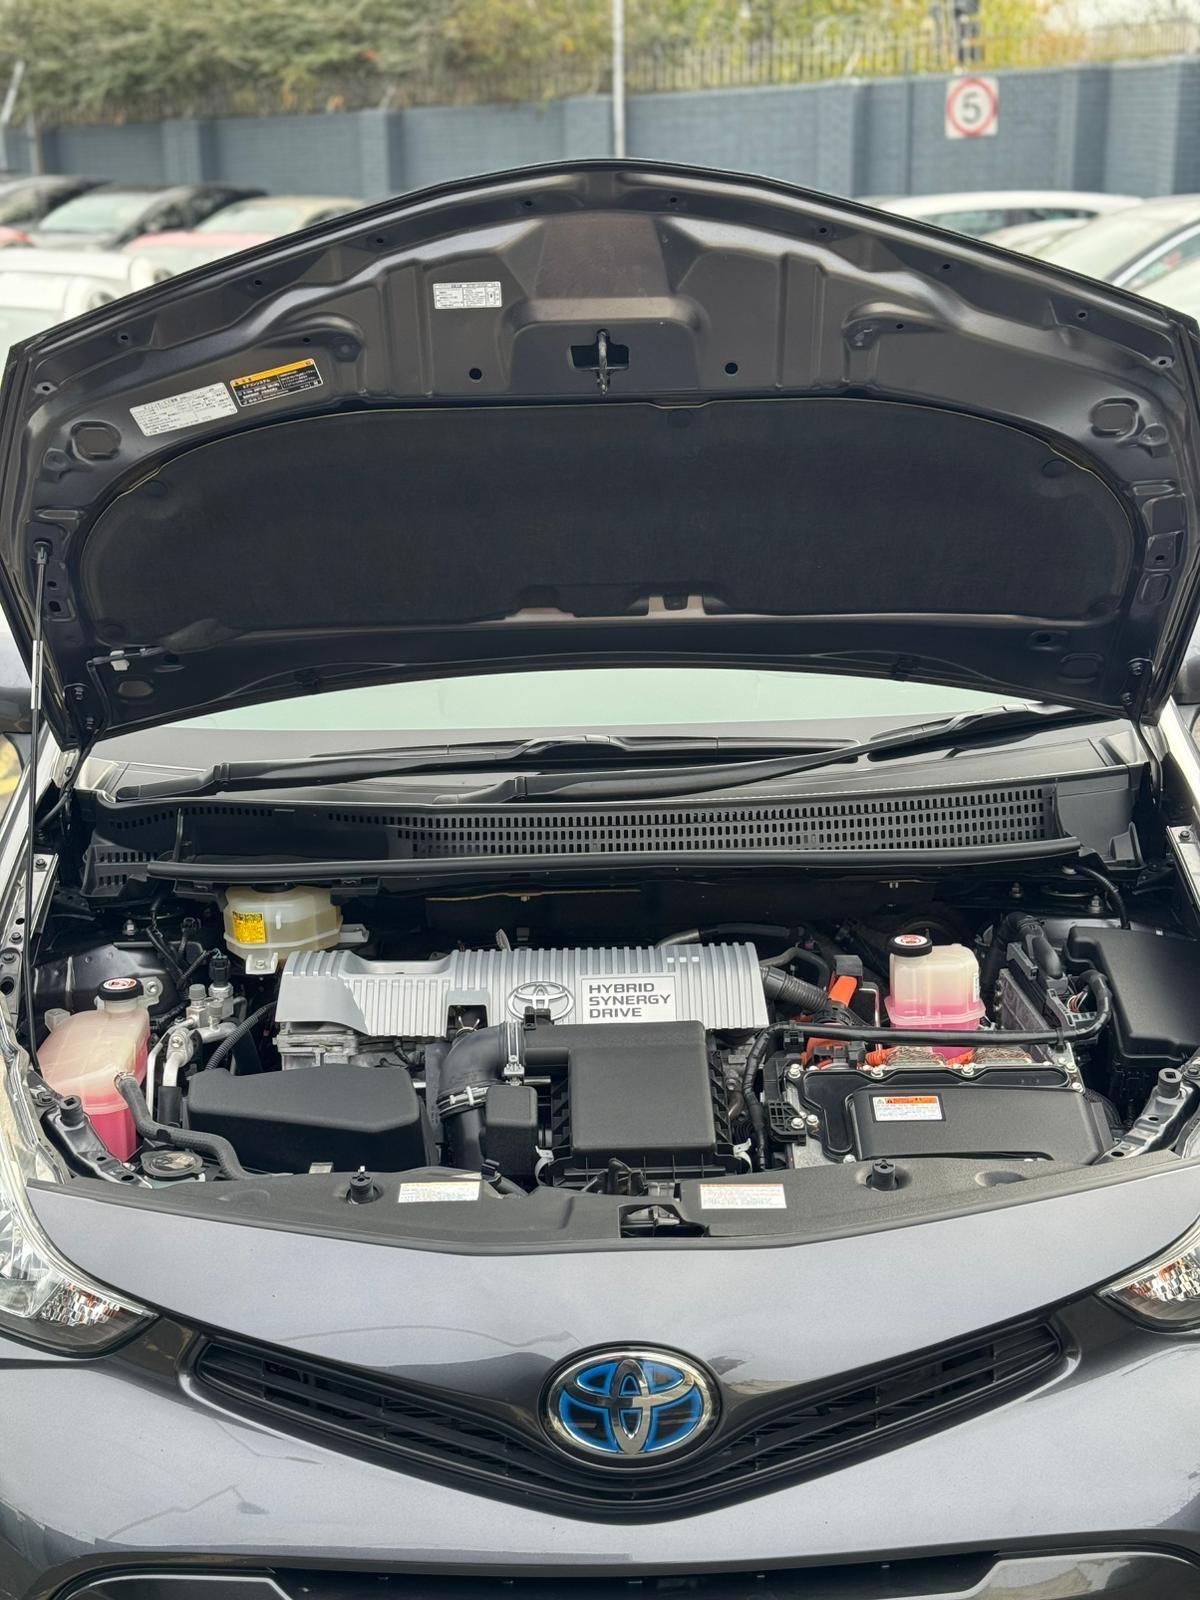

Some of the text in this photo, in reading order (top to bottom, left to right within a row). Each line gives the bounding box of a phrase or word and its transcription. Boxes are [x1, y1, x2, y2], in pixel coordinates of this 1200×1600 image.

[962, 91, 981, 124] 5
[588, 982, 655, 994] HYBRID
[588, 994, 671, 1007] SYNERGY
[589, 1007, 642, 1019] DRIVE
